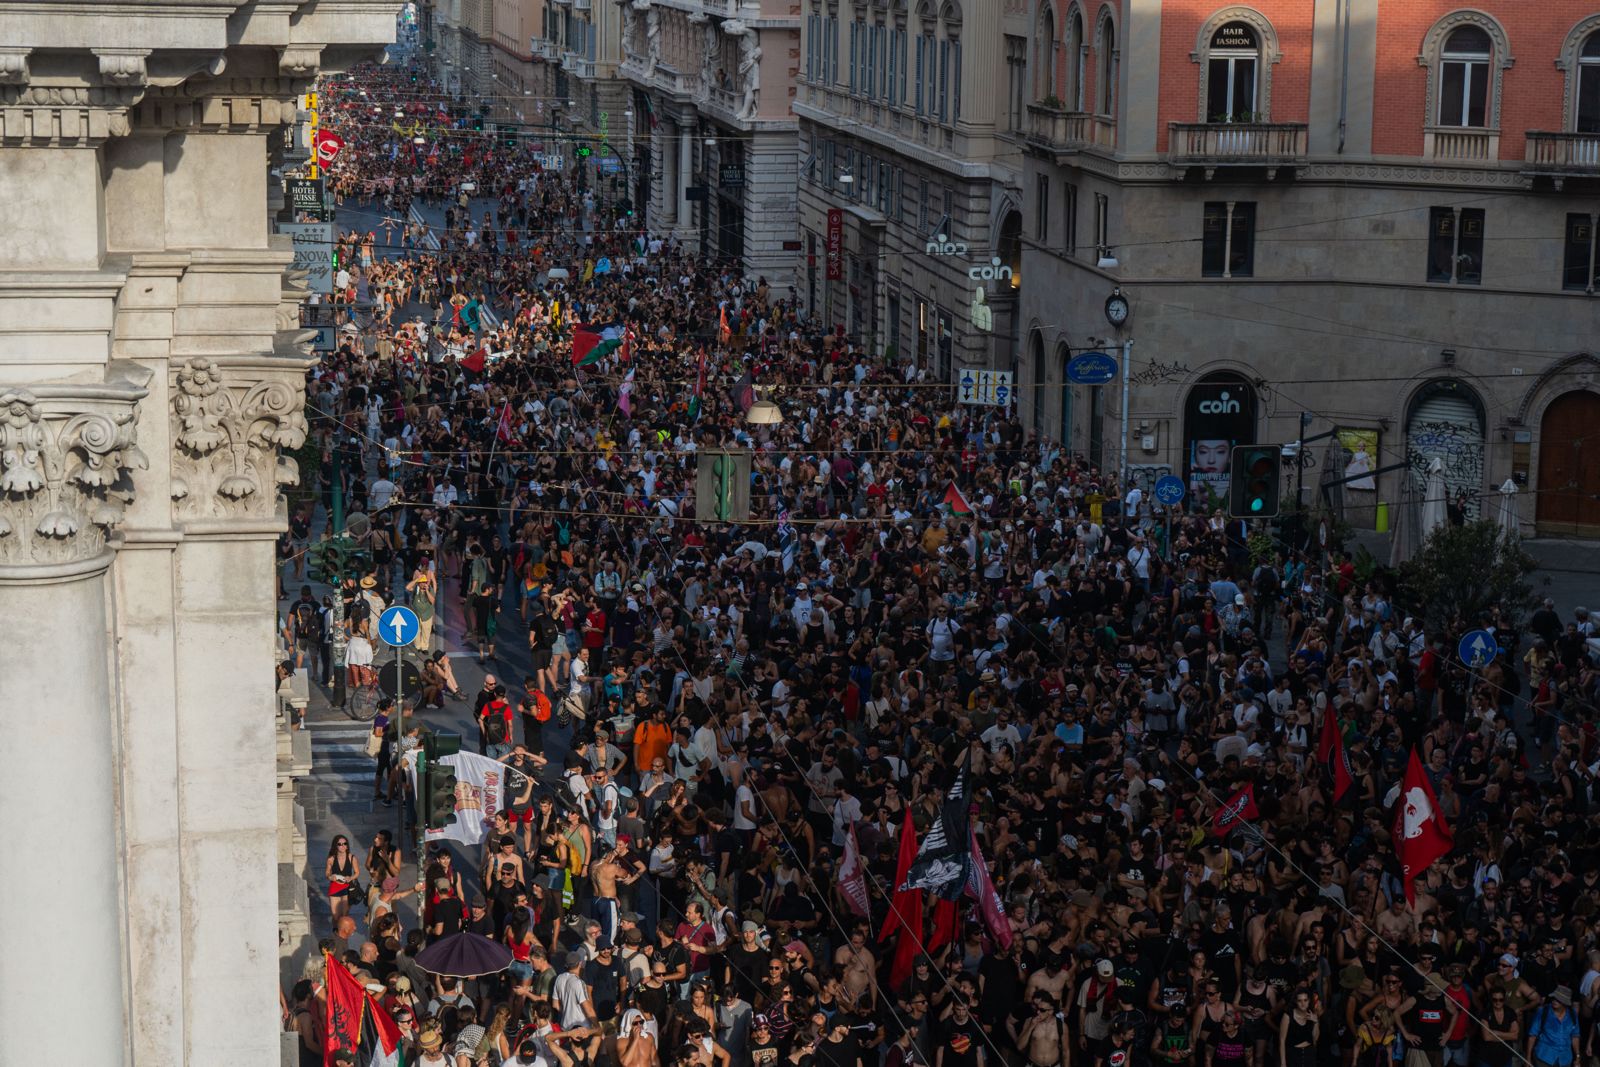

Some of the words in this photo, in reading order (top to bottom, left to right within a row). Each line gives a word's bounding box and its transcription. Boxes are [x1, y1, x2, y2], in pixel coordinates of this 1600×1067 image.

[292, 186, 317, 194] HOTEL
[293, 250, 330, 262] ENOVA
[968, 256, 1013, 281] coin
[1199, 391, 1240, 414] coin
